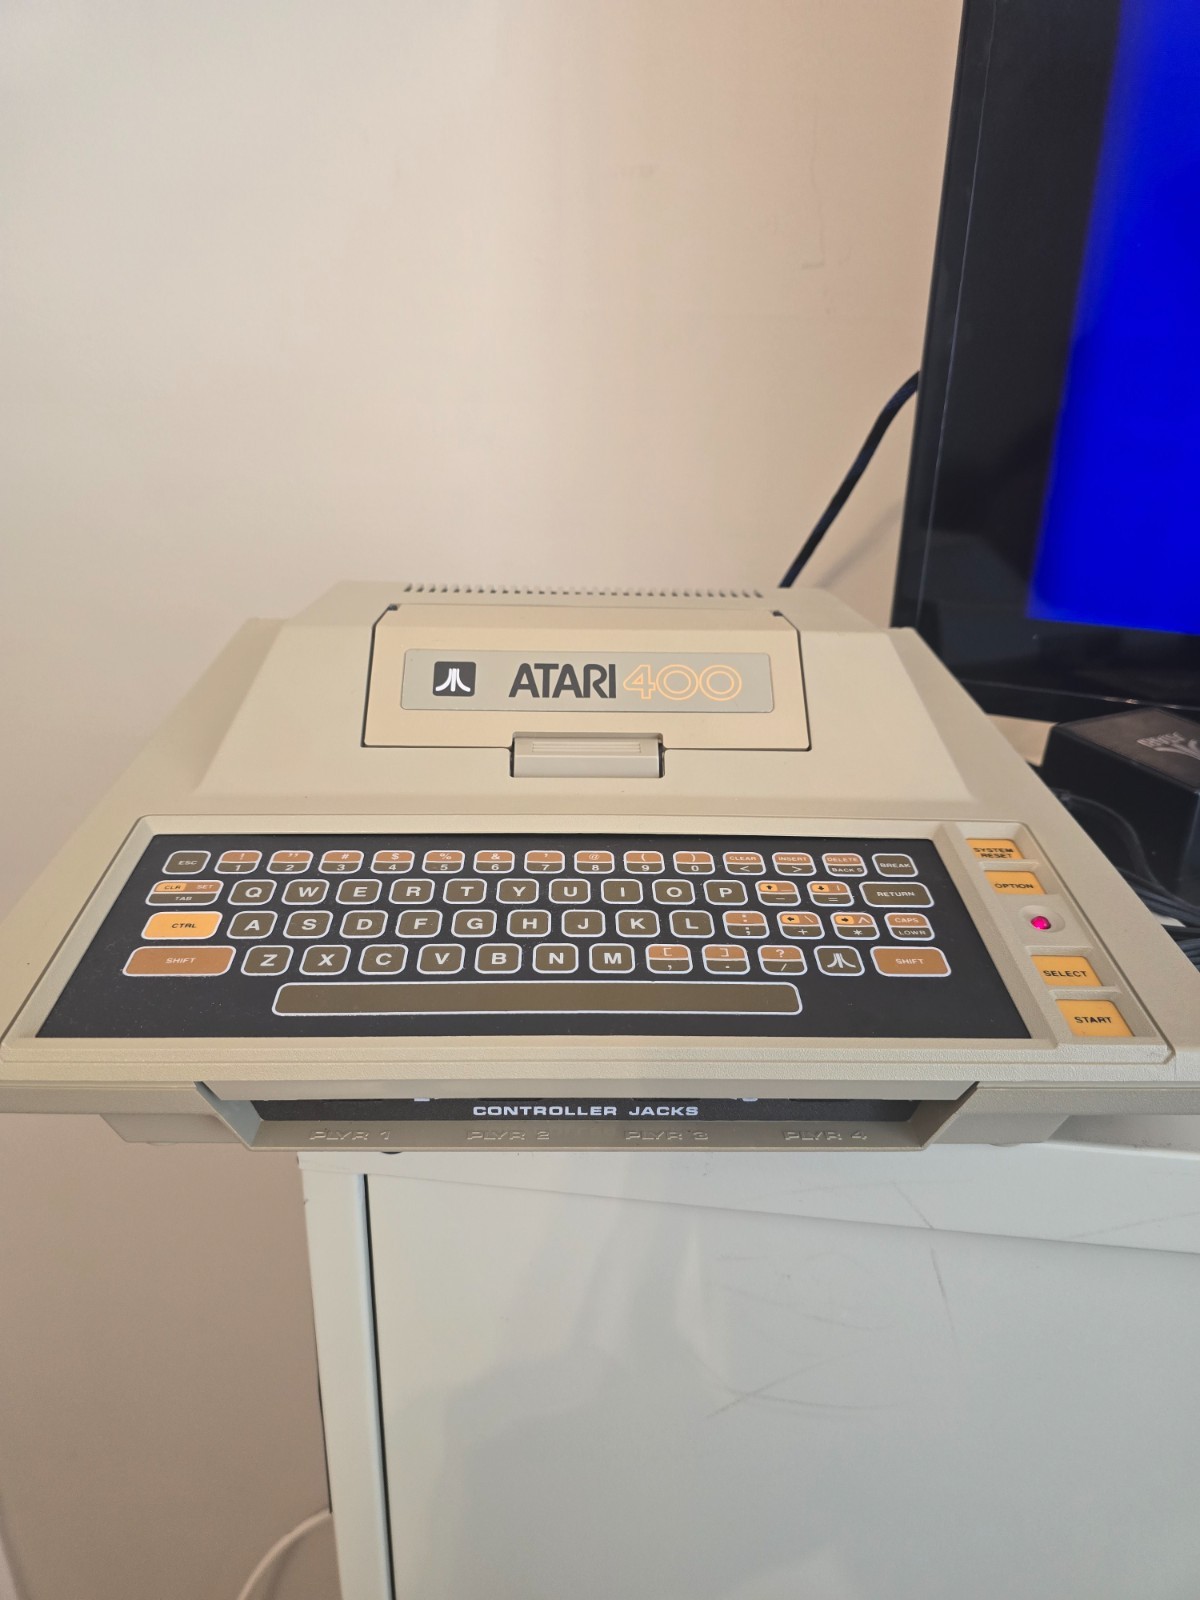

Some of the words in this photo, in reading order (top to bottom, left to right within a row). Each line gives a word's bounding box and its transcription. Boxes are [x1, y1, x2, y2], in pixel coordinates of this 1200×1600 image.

[509, 663, 616, 698] ATARI
[623, 664, 742, 700] 400
[245, 887, 262, 897] Q
[299, 887, 319, 897] W
[353, 887, 367, 897] E
[406, 887, 421, 896] R
[461, 887, 474, 896] T
[513, 887, 526, 896] Y
[564, 887, 577, 896] U
[621, 887, 624, 896] I
[667, 887, 682, 897] O
[720, 888, 732, 897] P
[244, 920, 259, 930] A
[302, 919, 317, 930] S
[357, 919, 372, 930] D
[414, 919, 428, 929] F
[467, 918, 483, 929] G
[523, 918, 537, 929] H
[578, 918, 588, 929] J
[631, 918, 645, 929] K
[686, 918, 698, 929] L
[260, 954, 277, 966] Z
[318, 954, 335, 966] X
[376, 954, 392, 965] C
[435, 953, 449, 964] V
[492, 953, 506, 964] B
[549, 953, 564, 964] N
[604, 953, 621, 964] M
[473, 1106, 617, 1115] CONTROLLER
[629, 1106, 698, 1116] JACKS
[309, 1131, 368, 1140] PLYR
[380, 1131, 391, 1140] 1
[466, 1131, 525, 1140] PLYR
[537, 1131, 550, 1140] 2
[624, 1131, 683, 1140] PLYR
[693, 1131, 708, 1140] 3
[784, 1131, 842, 1140] PLYR
[852, 1131, 867, 1140] 4
